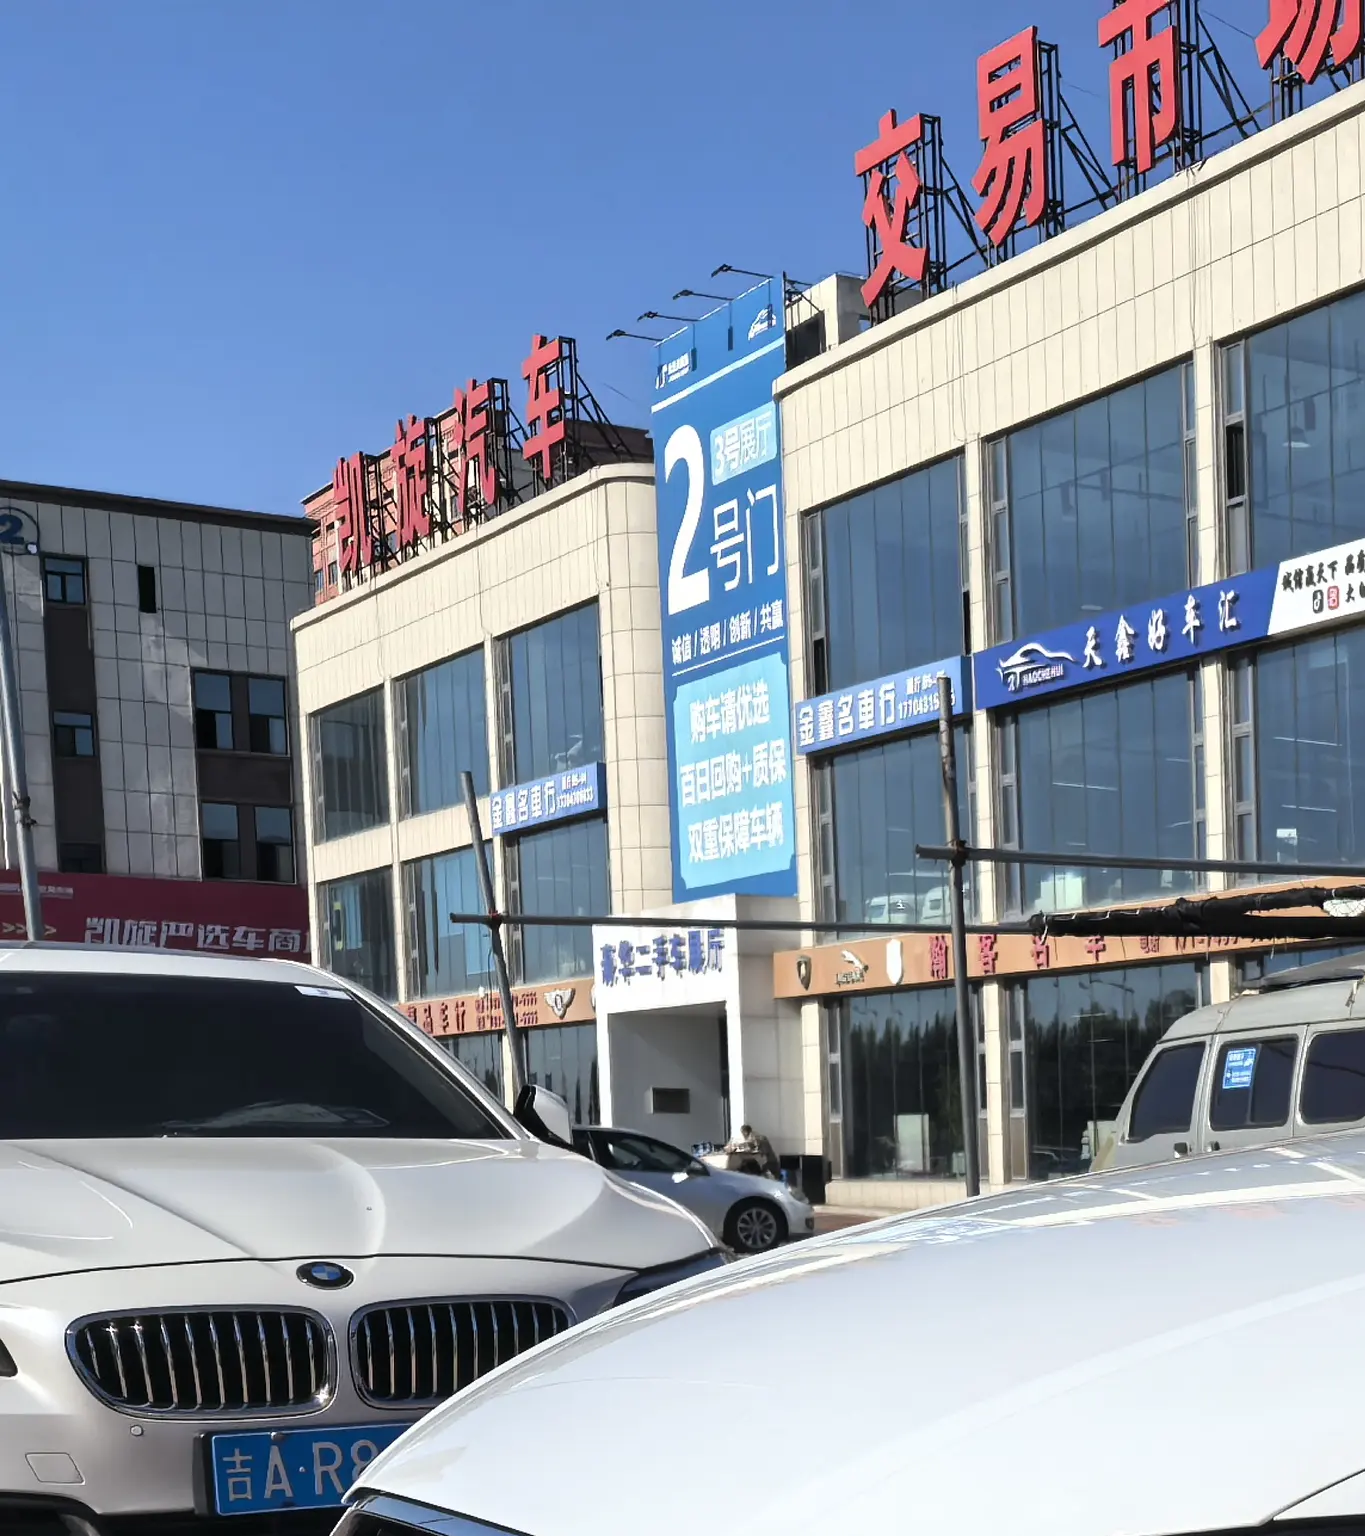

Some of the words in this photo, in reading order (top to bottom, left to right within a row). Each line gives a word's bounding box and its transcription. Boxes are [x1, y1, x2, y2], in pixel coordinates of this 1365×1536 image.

[332, 334, 565, 573] 凯旋汽车
[713, 411, 773, 476] 3号展厅
[1083, 590, 1240, 668] 天鑫好车汇
[689, 677, 770, 744] 购车请优选
[687, 800, 784, 864] 双重保障车辆
[84, 917, 311, 953] 凯旋严选车商
